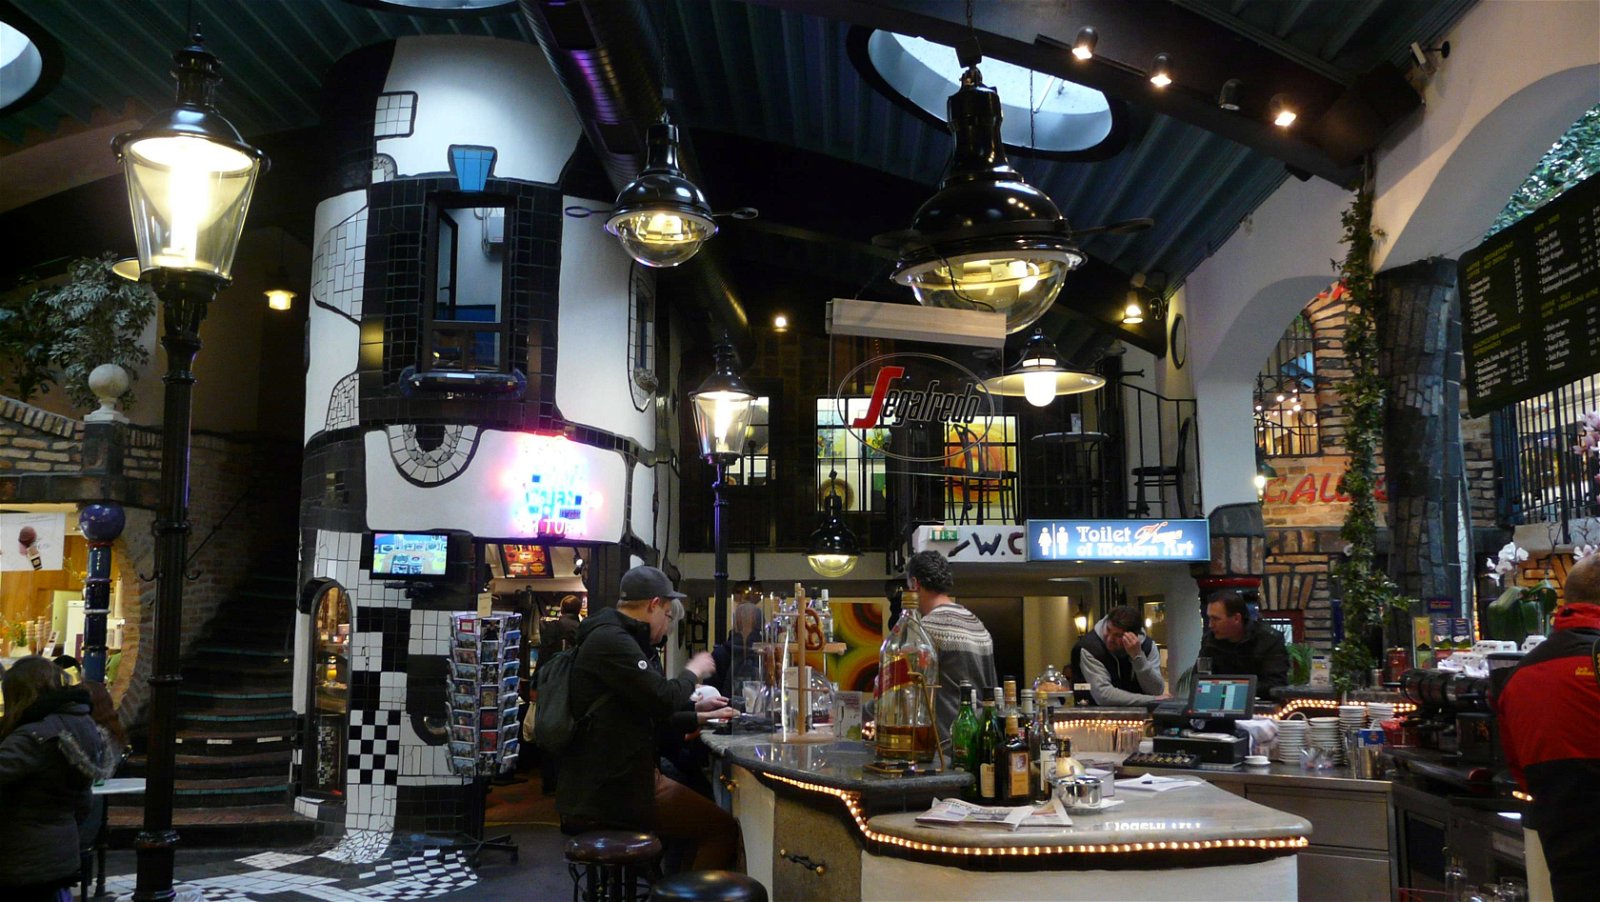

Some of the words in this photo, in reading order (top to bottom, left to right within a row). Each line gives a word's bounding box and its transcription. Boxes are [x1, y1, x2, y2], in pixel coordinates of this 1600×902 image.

[853, 366, 980, 429] Segafredo
[1076, 526, 1131, 543] Toilet
[1076, 543, 1093, 557] of
[1097, 543, 1158, 557] Modern
[1162, 540, 1194, 557] Art
